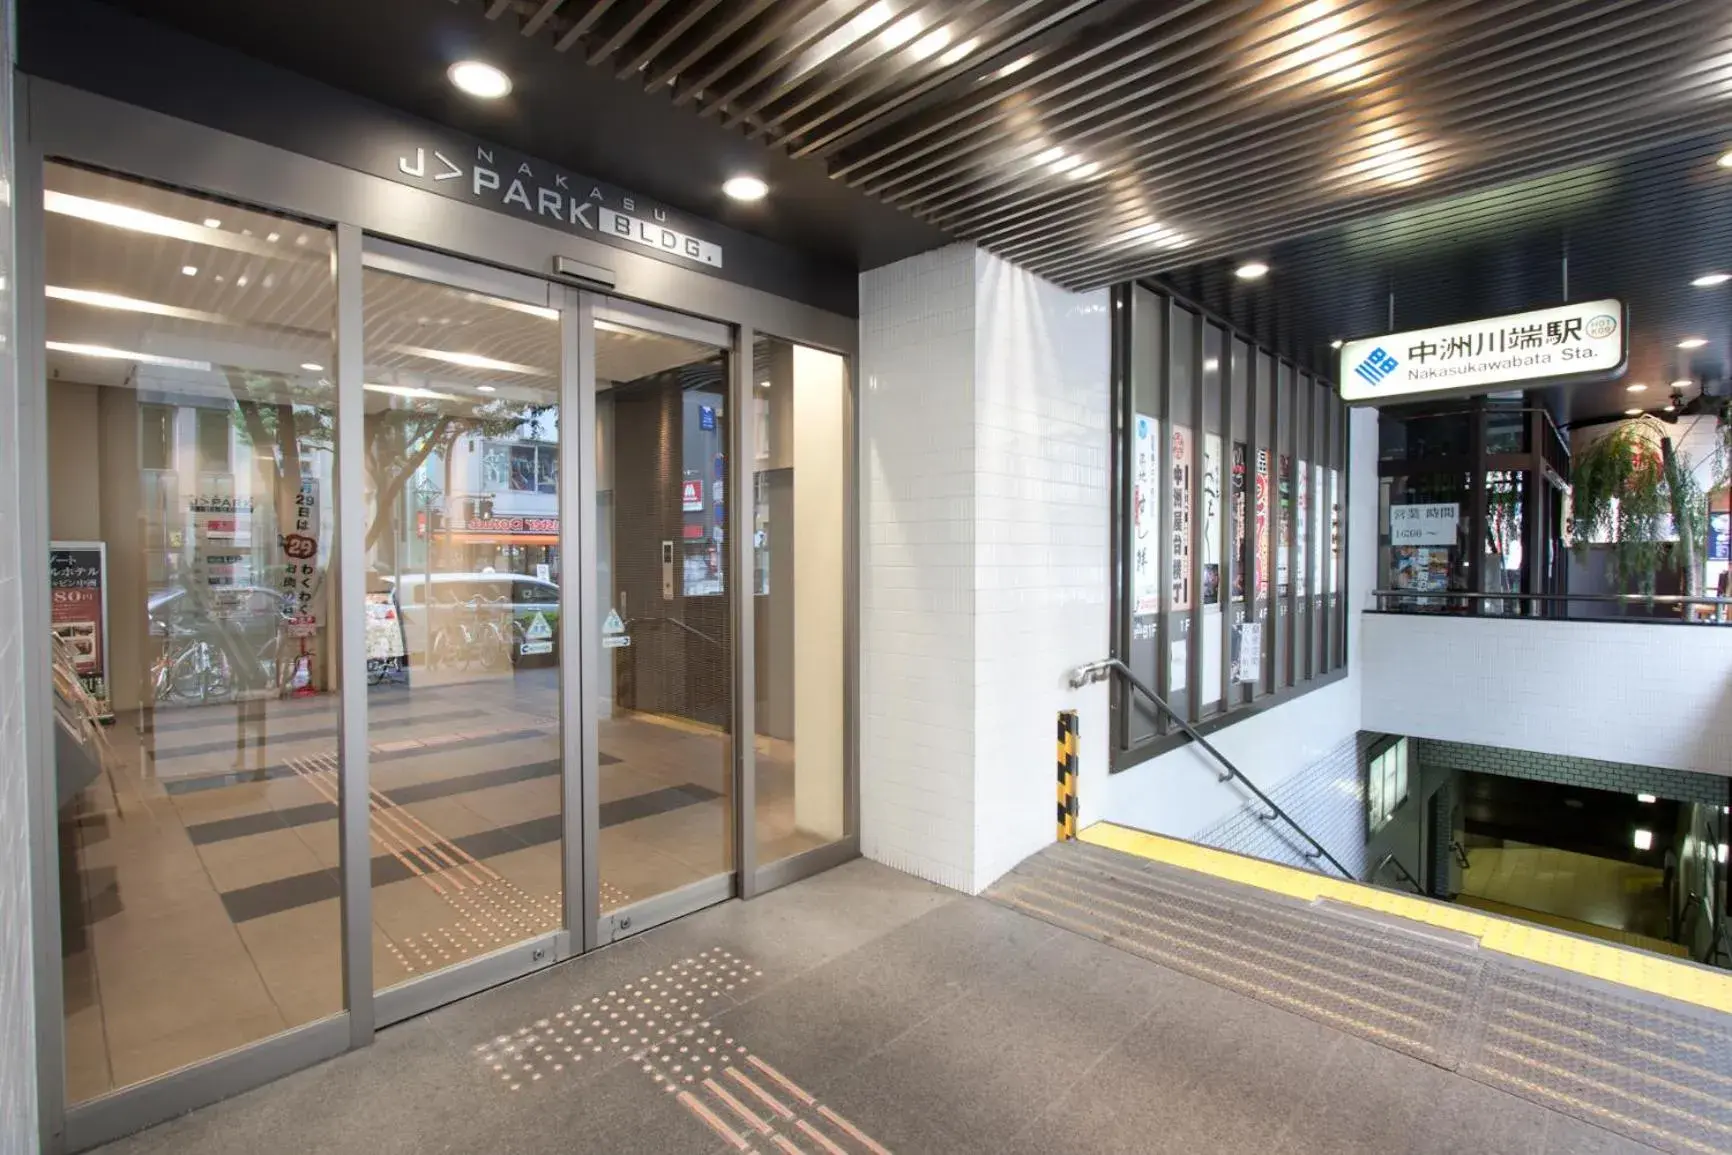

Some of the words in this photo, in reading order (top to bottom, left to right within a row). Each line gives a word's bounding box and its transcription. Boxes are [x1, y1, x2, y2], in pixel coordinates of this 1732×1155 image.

[477, 145, 667, 223] NAKASU
[615, 215, 712, 262] BLDG.
[1408, 316, 1583, 366] 中洲川端駅
[1408, 352, 1552, 381] Nakasukawabata
[1561, 344, 1598, 361] Sta.
